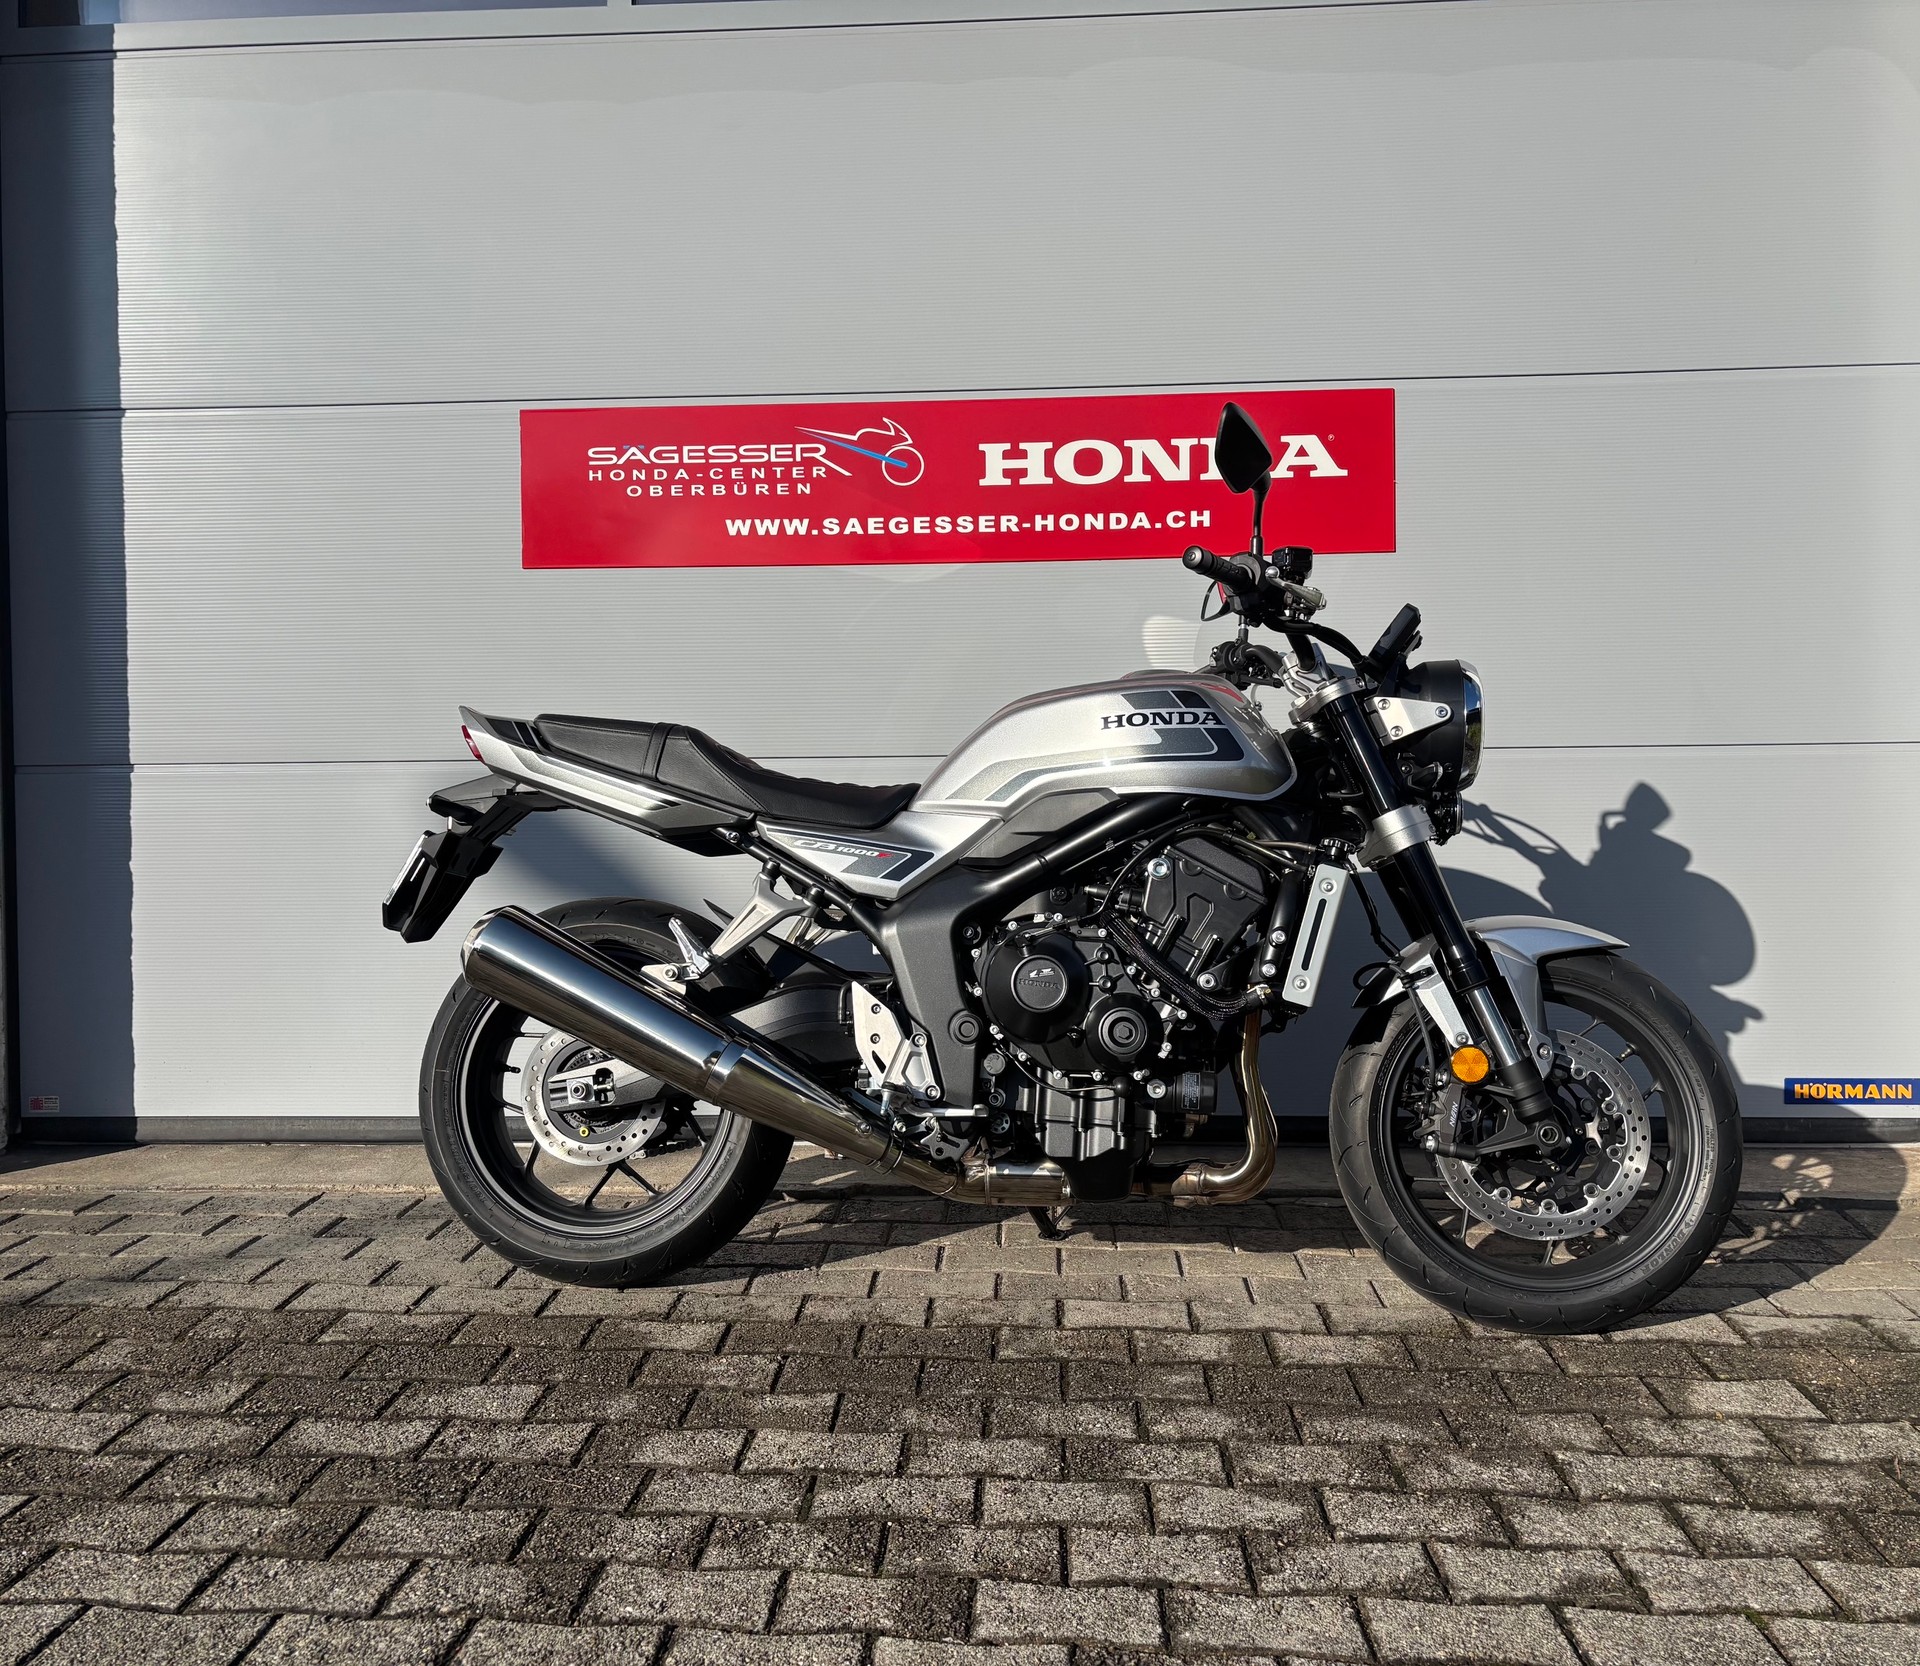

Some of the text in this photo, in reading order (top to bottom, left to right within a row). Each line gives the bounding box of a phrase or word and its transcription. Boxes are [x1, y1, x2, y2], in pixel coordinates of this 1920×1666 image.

[587, 444, 846, 474] SÄGESSER
[978, 434, 1348, 487] HONA
[588, 466, 827, 481] HONDA-CENTER
[626, 482, 812, 497] OBERBÜREN
[725, 510, 1212, 537] WWW.SAEGESSER-HONDA.CH
[1100, 711, 1226, 730] HONDA
[1018, 978, 1062, 990] HONDA
[1794, 1083, 1913, 1099] HÖRMANN
